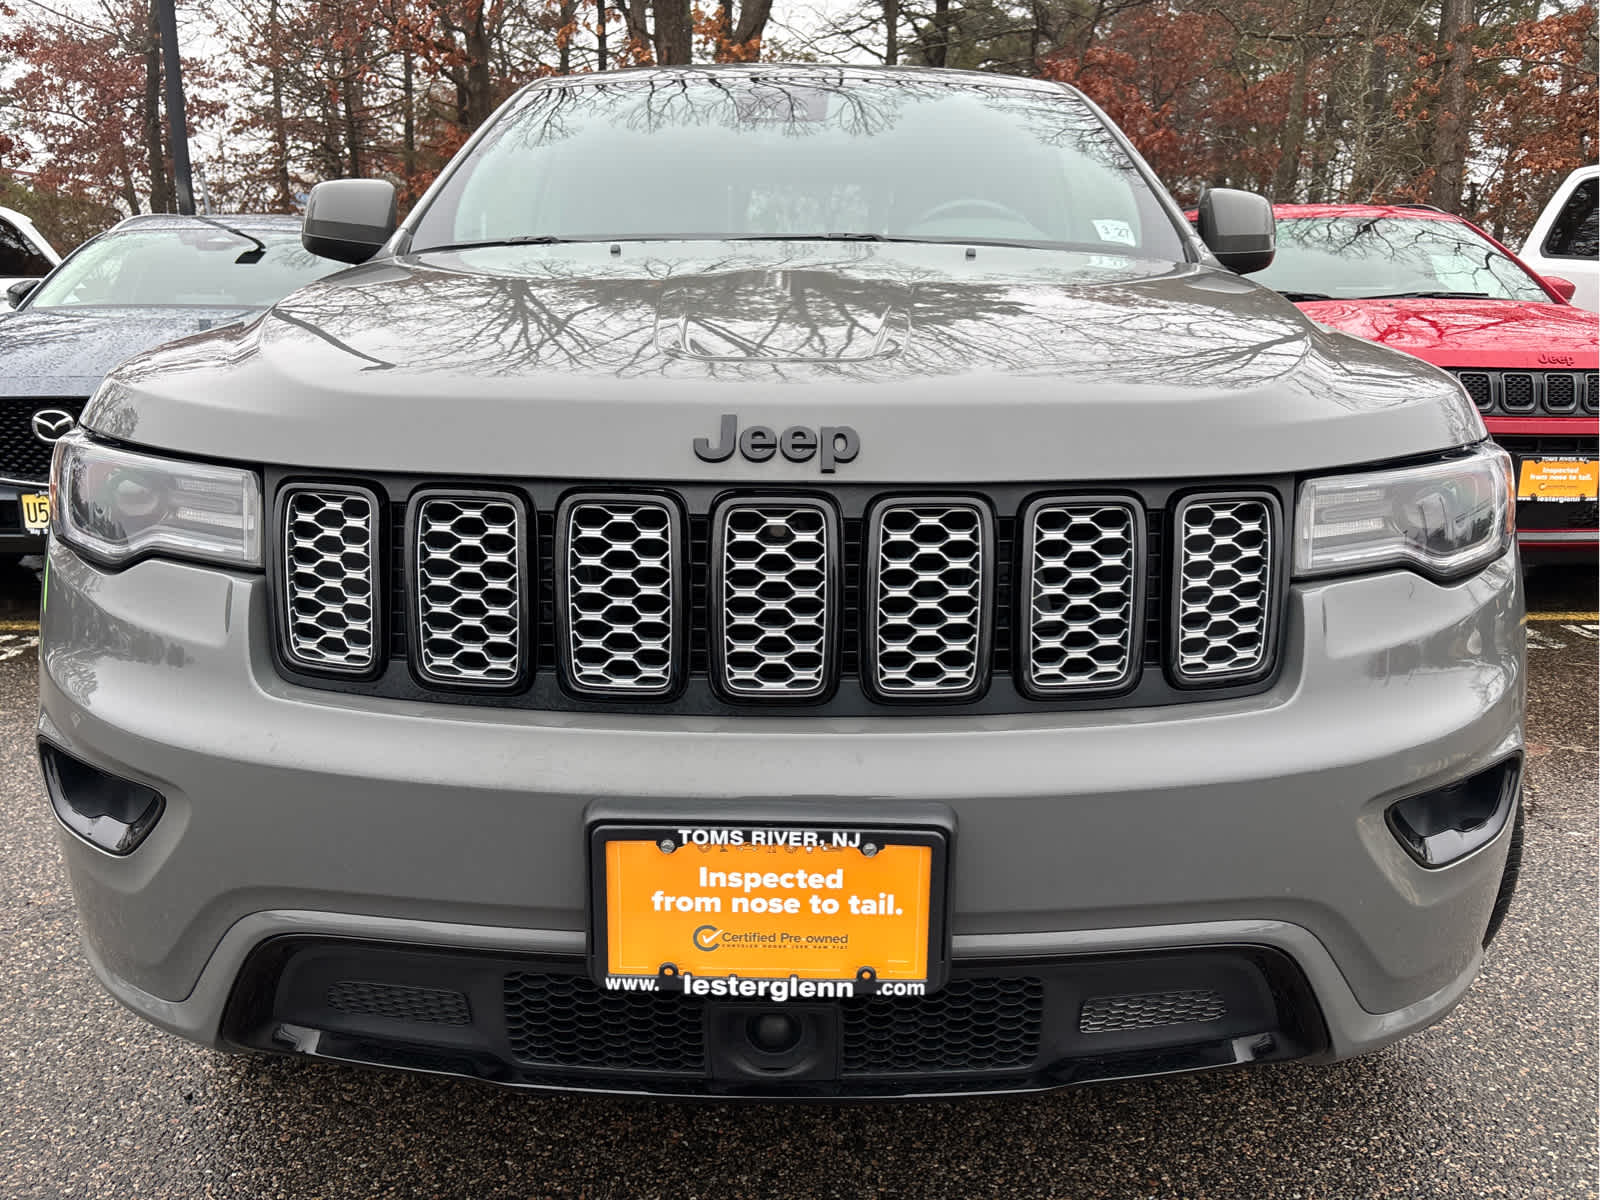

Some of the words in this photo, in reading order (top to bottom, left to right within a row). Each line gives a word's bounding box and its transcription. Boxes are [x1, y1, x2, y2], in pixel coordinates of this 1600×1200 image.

[1537, 353, 1575, 366] Jeep
[693, 414, 861, 474] Jeep
[678, 830, 744, 845] TOMS
[751, 831, 825, 847] RIVER,
[832, 832, 861, 848] NJ
[700, 867, 843, 892] Inspected
[651, 891, 721, 912] from
[732, 896, 801, 913] nose
[809, 895, 840, 914] to
[848, 893, 903, 915] tail.
[722, 932, 777, 943] Certified
[605, 977, 660, 991] www.
[684, 974, 854, 1001] lesterglenn
[876, 982, 925, 996] .com
